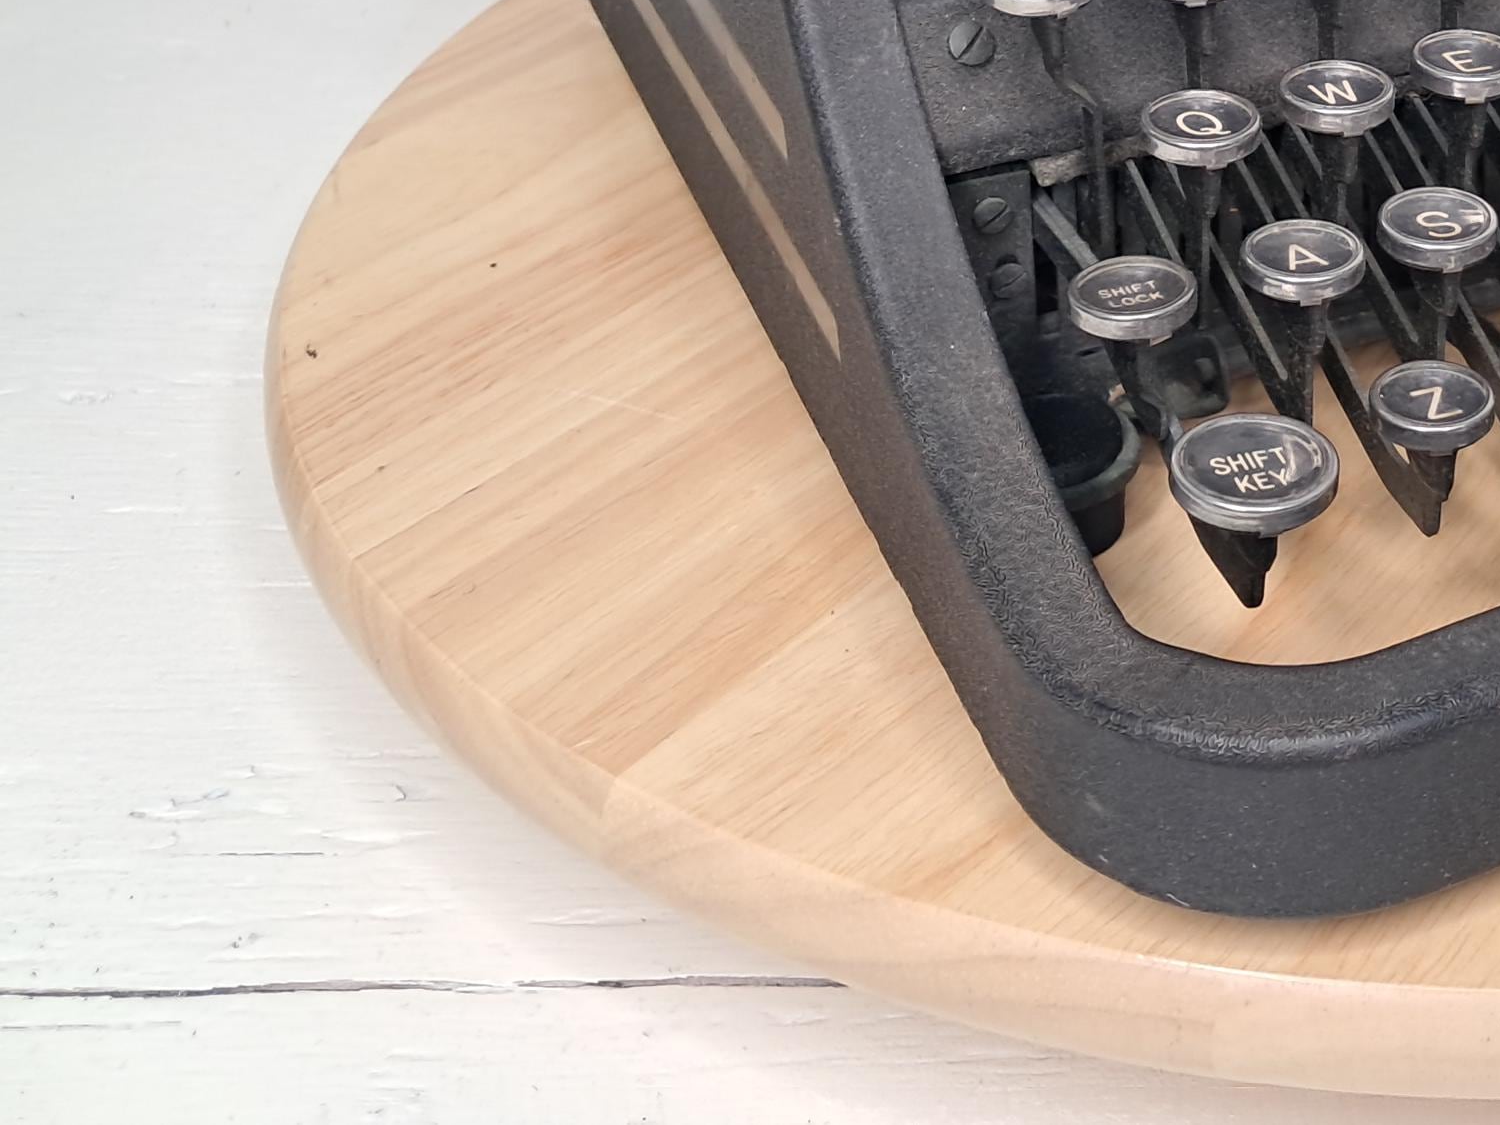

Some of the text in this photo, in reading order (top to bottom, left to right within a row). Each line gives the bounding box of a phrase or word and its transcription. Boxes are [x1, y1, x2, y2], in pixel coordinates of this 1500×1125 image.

[1442, 49, 1494, 73] E
[1307, 80, 1359, 106] W
[1176, 111, 1231, 136] Q
[1415, 211, 1463, 238] S
[1287, 242, 1329, 271] A
[1097, 278, 1158, 300] SHIFT
[1107, 290, 1166, 309] LOCK
[1409, 385, 1463, 421] Z
[1208, 446, 1287, 477] SHIFT
[1232, 467, 1292, 493] KEY
